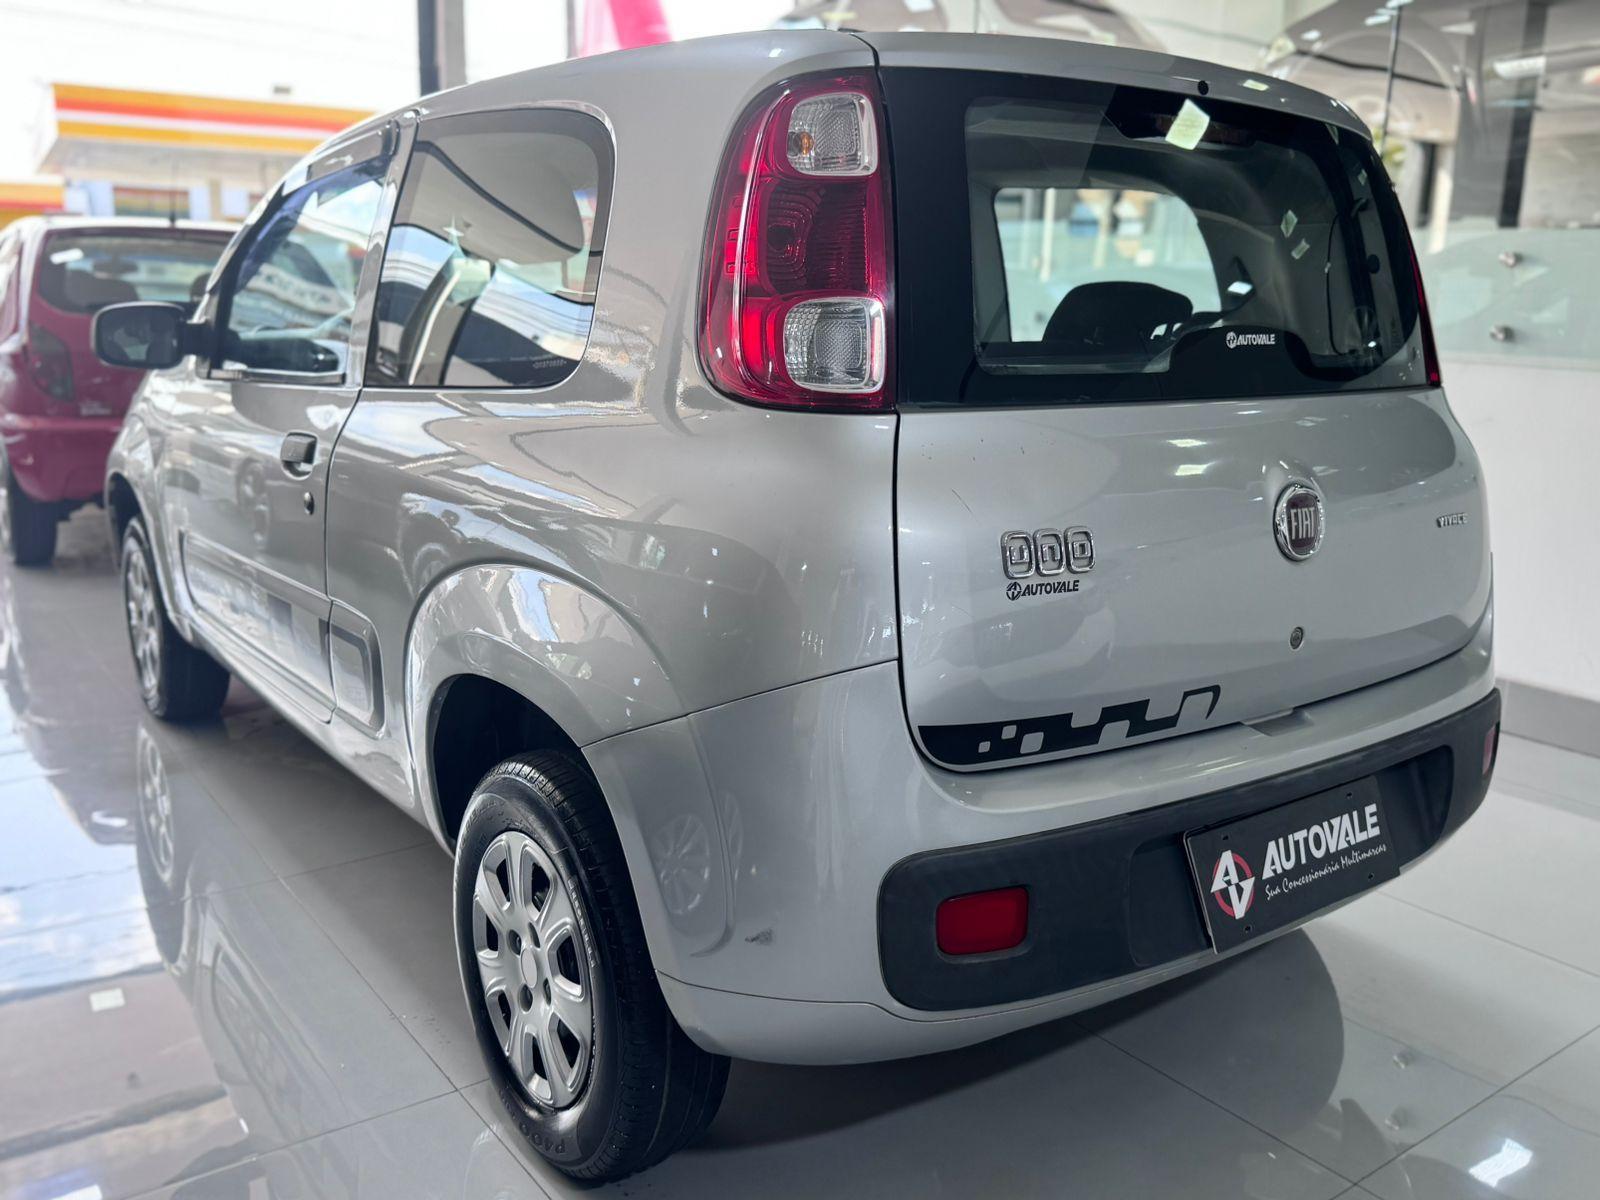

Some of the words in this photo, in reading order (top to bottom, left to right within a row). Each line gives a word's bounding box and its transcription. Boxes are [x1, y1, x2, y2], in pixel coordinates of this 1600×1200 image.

[1236, 334, 1275, 345] AUTOVALE
[1290, 507, 1315, 540] FIAT
[1021, 580, 1079, 597] AUTOVALE
[1262, 803, 1380, 880] AUTOVALE
[1265, 884, 1281, 901] Sua
